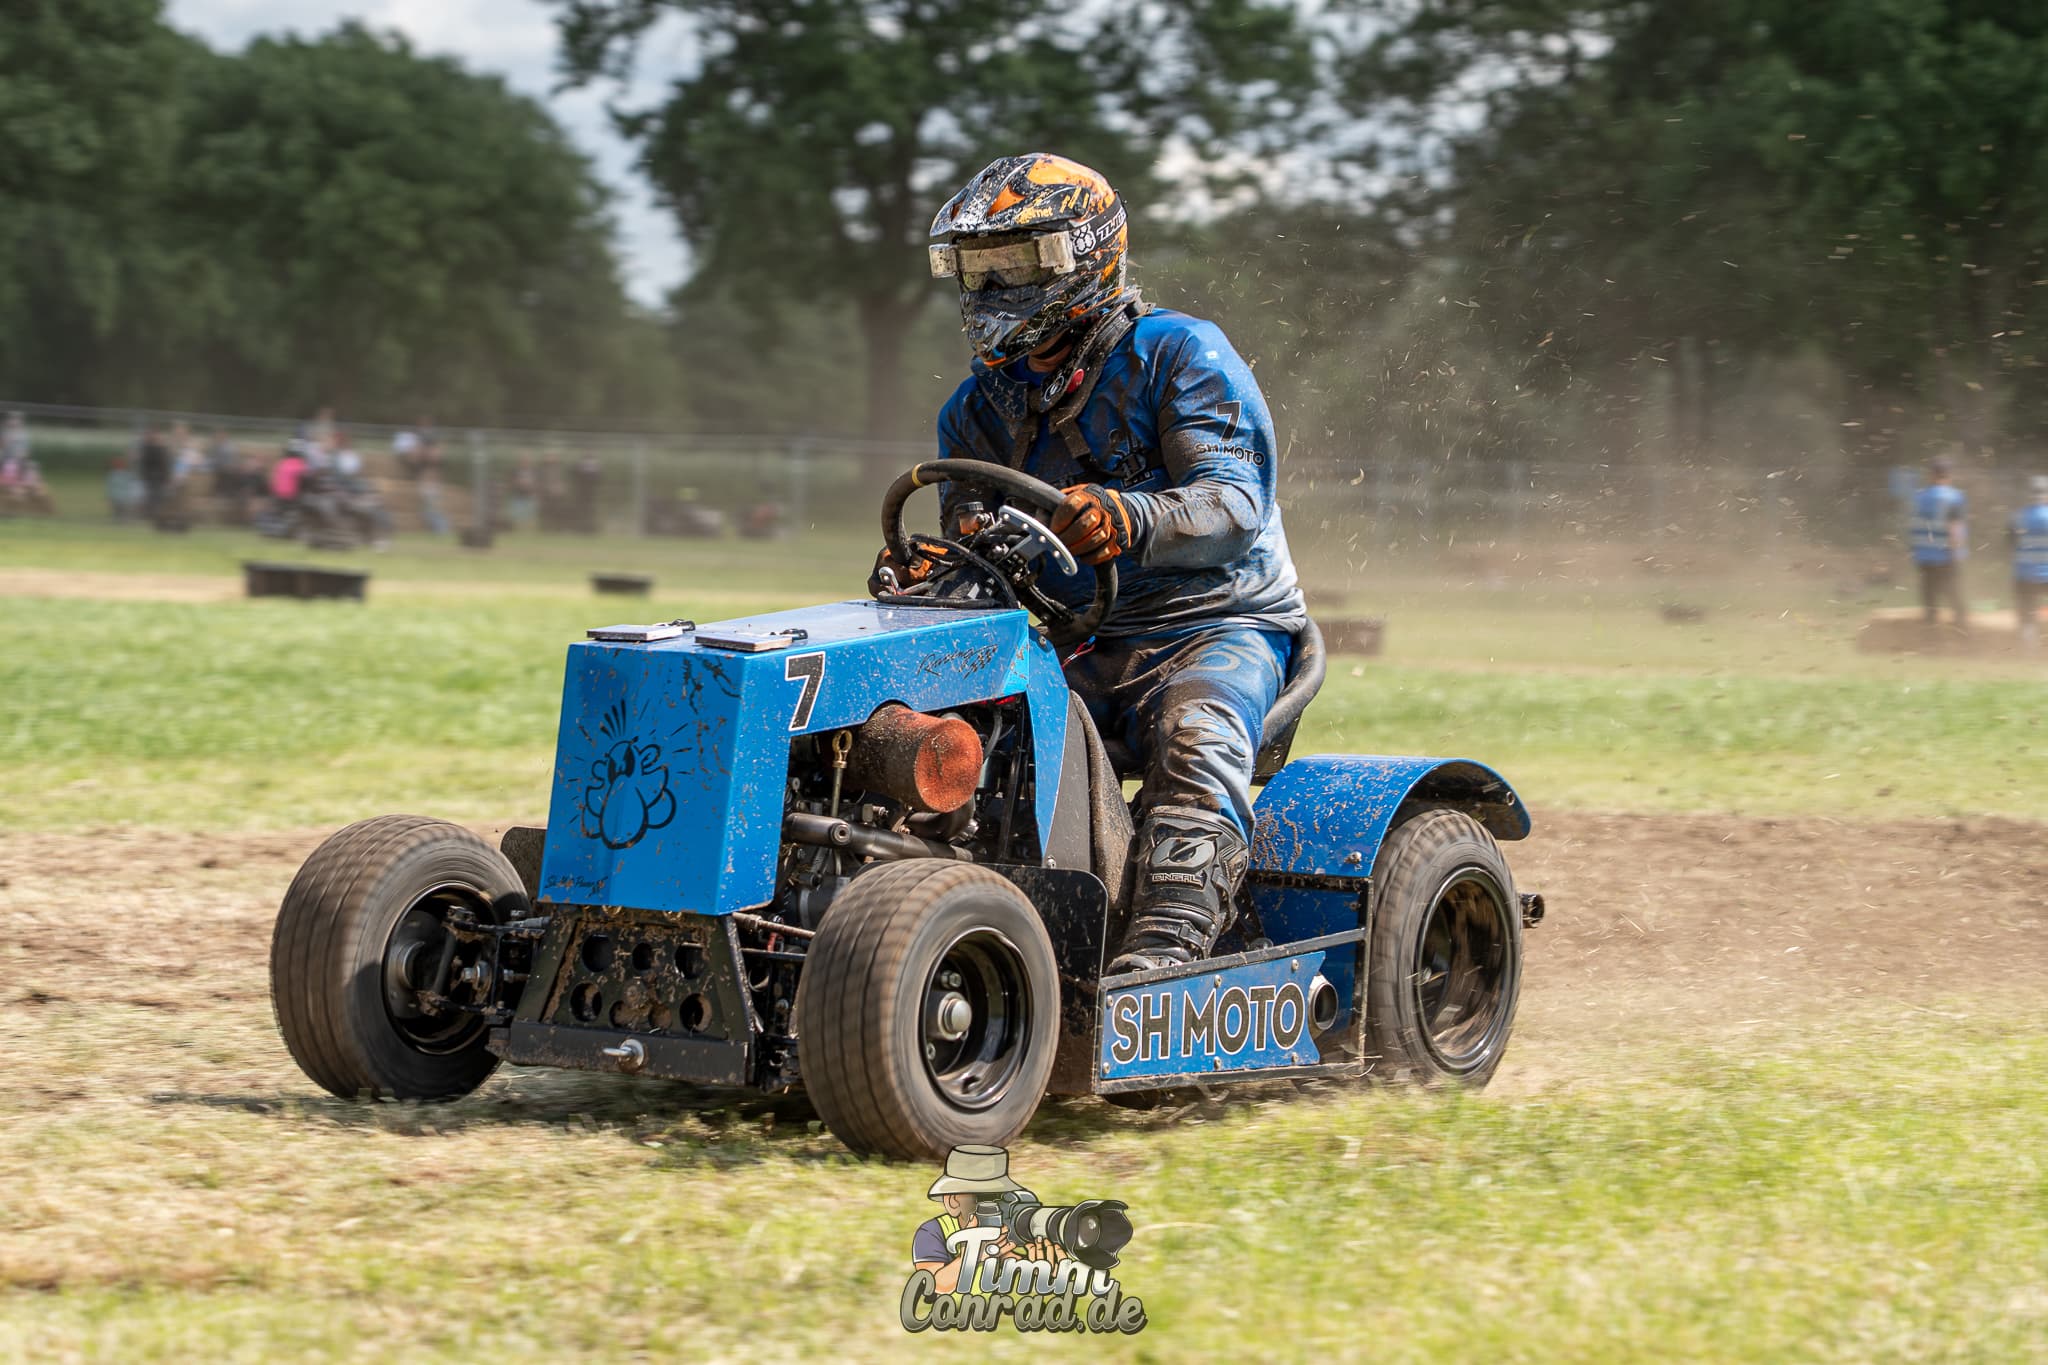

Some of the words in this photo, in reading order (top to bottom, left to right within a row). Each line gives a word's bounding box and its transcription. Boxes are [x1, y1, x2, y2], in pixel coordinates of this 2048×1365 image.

[1215, 400, 1242, 443] 7
[1194, 442, 1219, 454] SH
[1223, 444, 1265, 467] MOTO
[784, 651, 826, 731] 7
[1110, 991, 1172, 1065] SH
[1181, 982, 1305, 1058] MOTO
